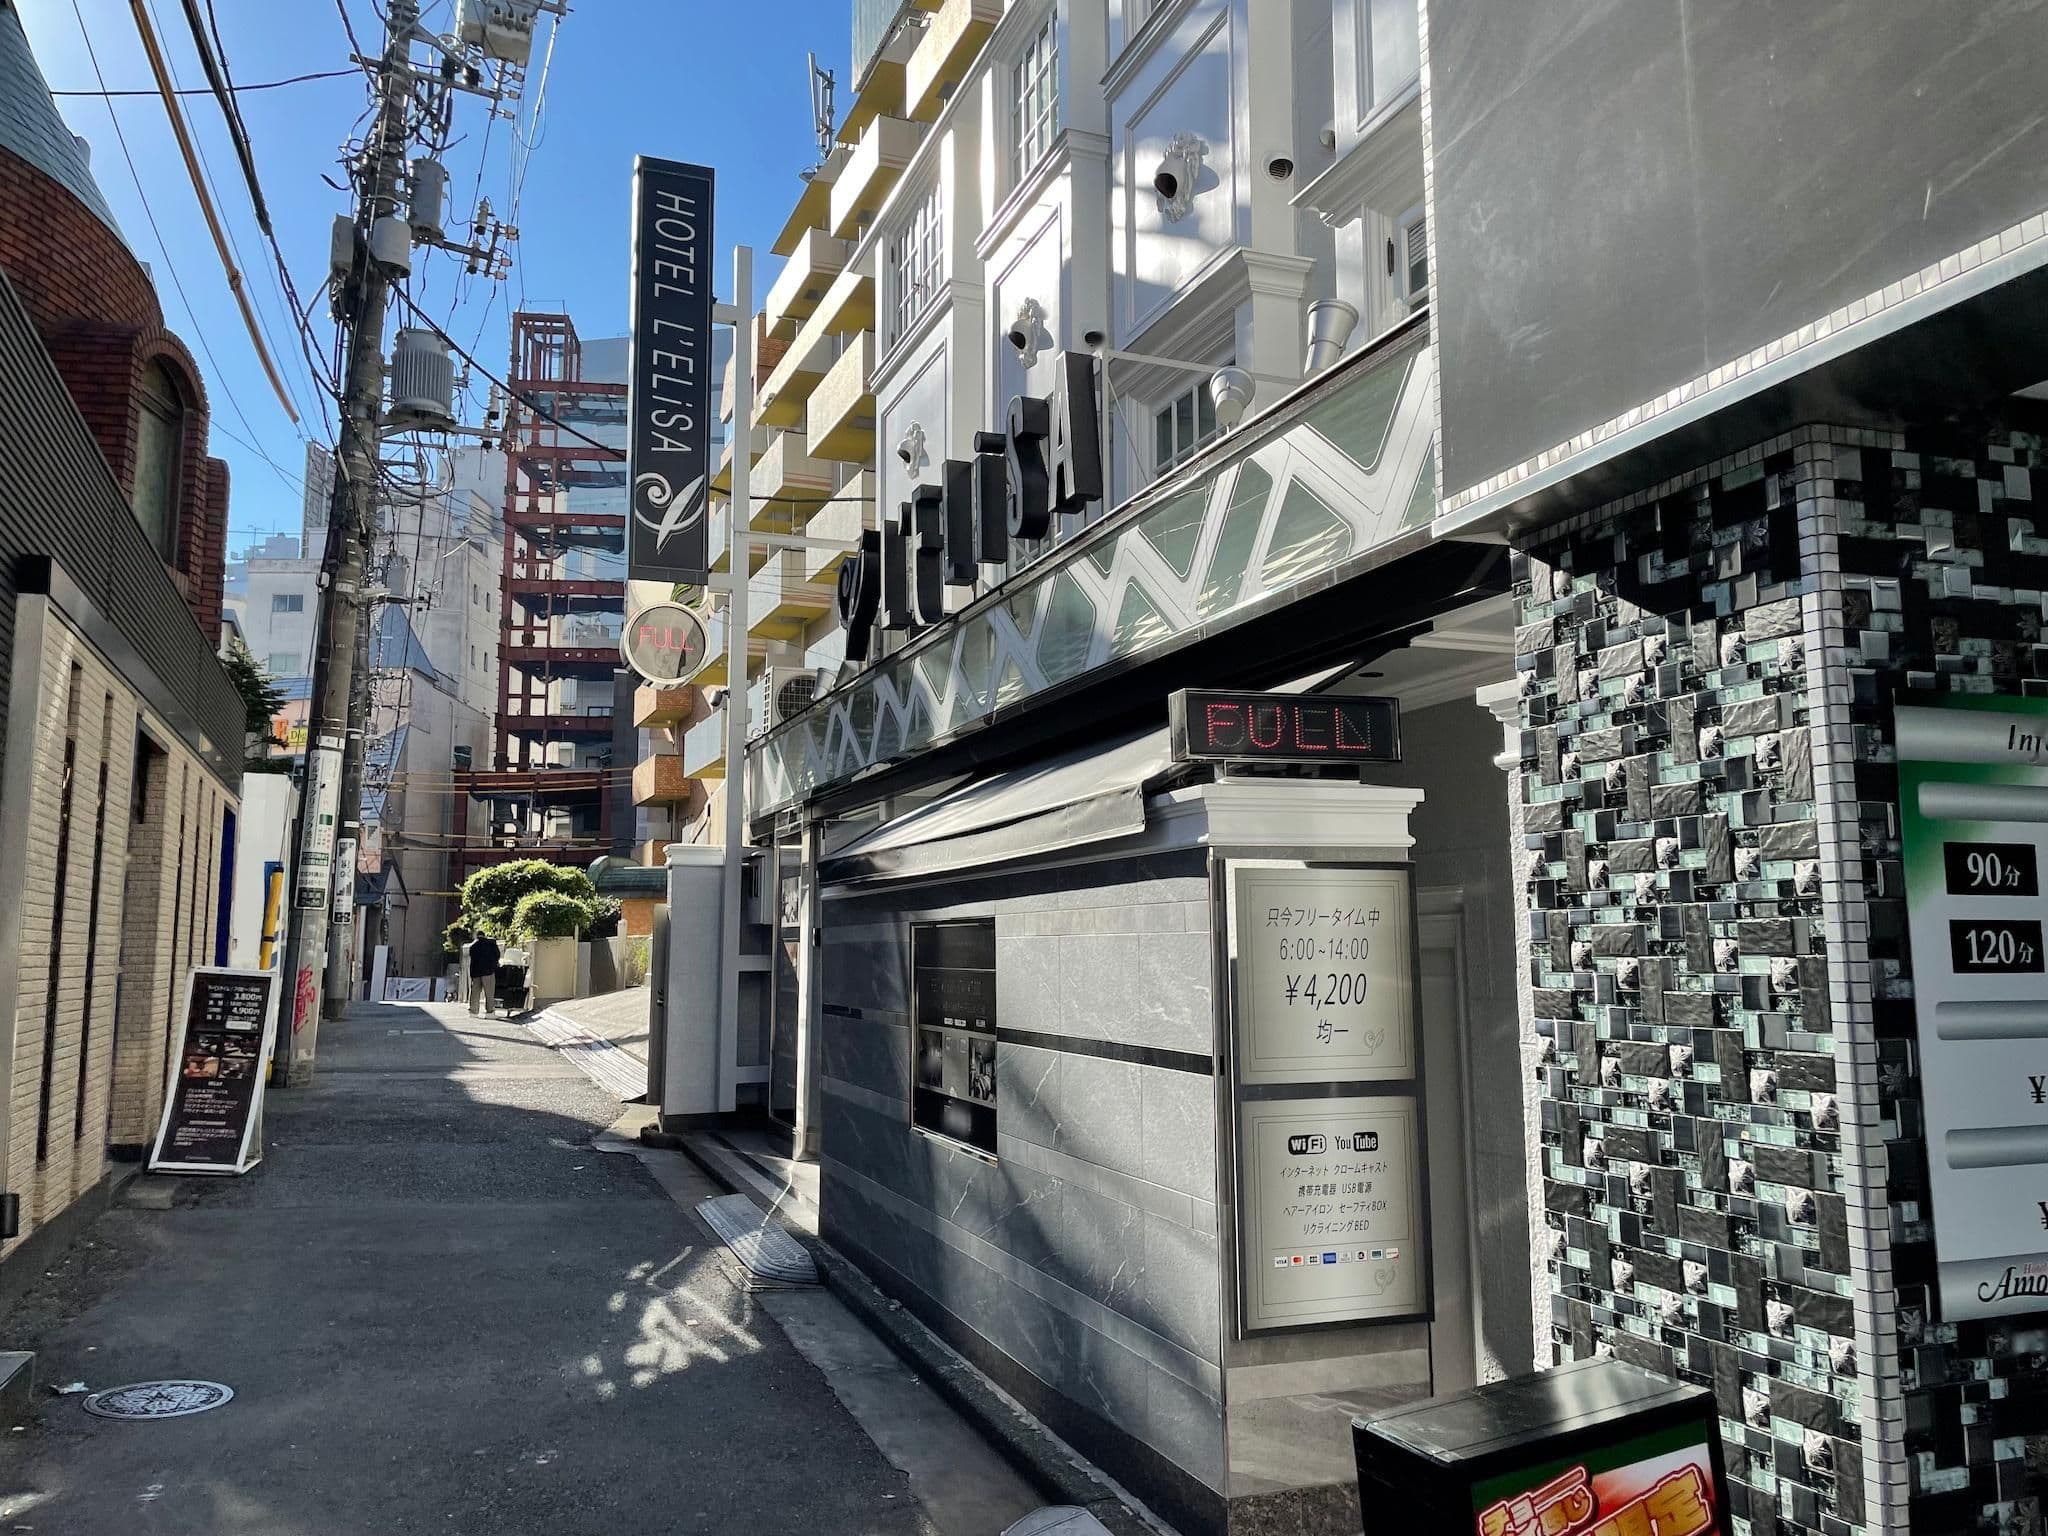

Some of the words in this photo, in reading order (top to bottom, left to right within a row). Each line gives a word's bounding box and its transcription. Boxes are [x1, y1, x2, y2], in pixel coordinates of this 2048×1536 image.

[655, 190, 695, 298] HOTEL
[639, 624, 694, 652] FULL
[1967, 852, 2021, 887] 90分
[1266, 906, 1381, 927] 只今フリータイム中
[1965, 929, 2034, 964] 120分
[1316, 1018, 1349, 1044] 均一
[1280, 1165, 1329, 1178] インターネット
[1334, 1161, 1388, 1175] クロームキャスト
[1298, 1183, 1337, 1198] 携帯充電器
[1342, 1181, 1373, 1194] USB電源
[1283, 1204, 1334, 1217] ヘアーアイロン
[1339, 1199, 1388, 1214] セーフティBOX
[1303, 1219, 1370, 1235] リクライニングBED
